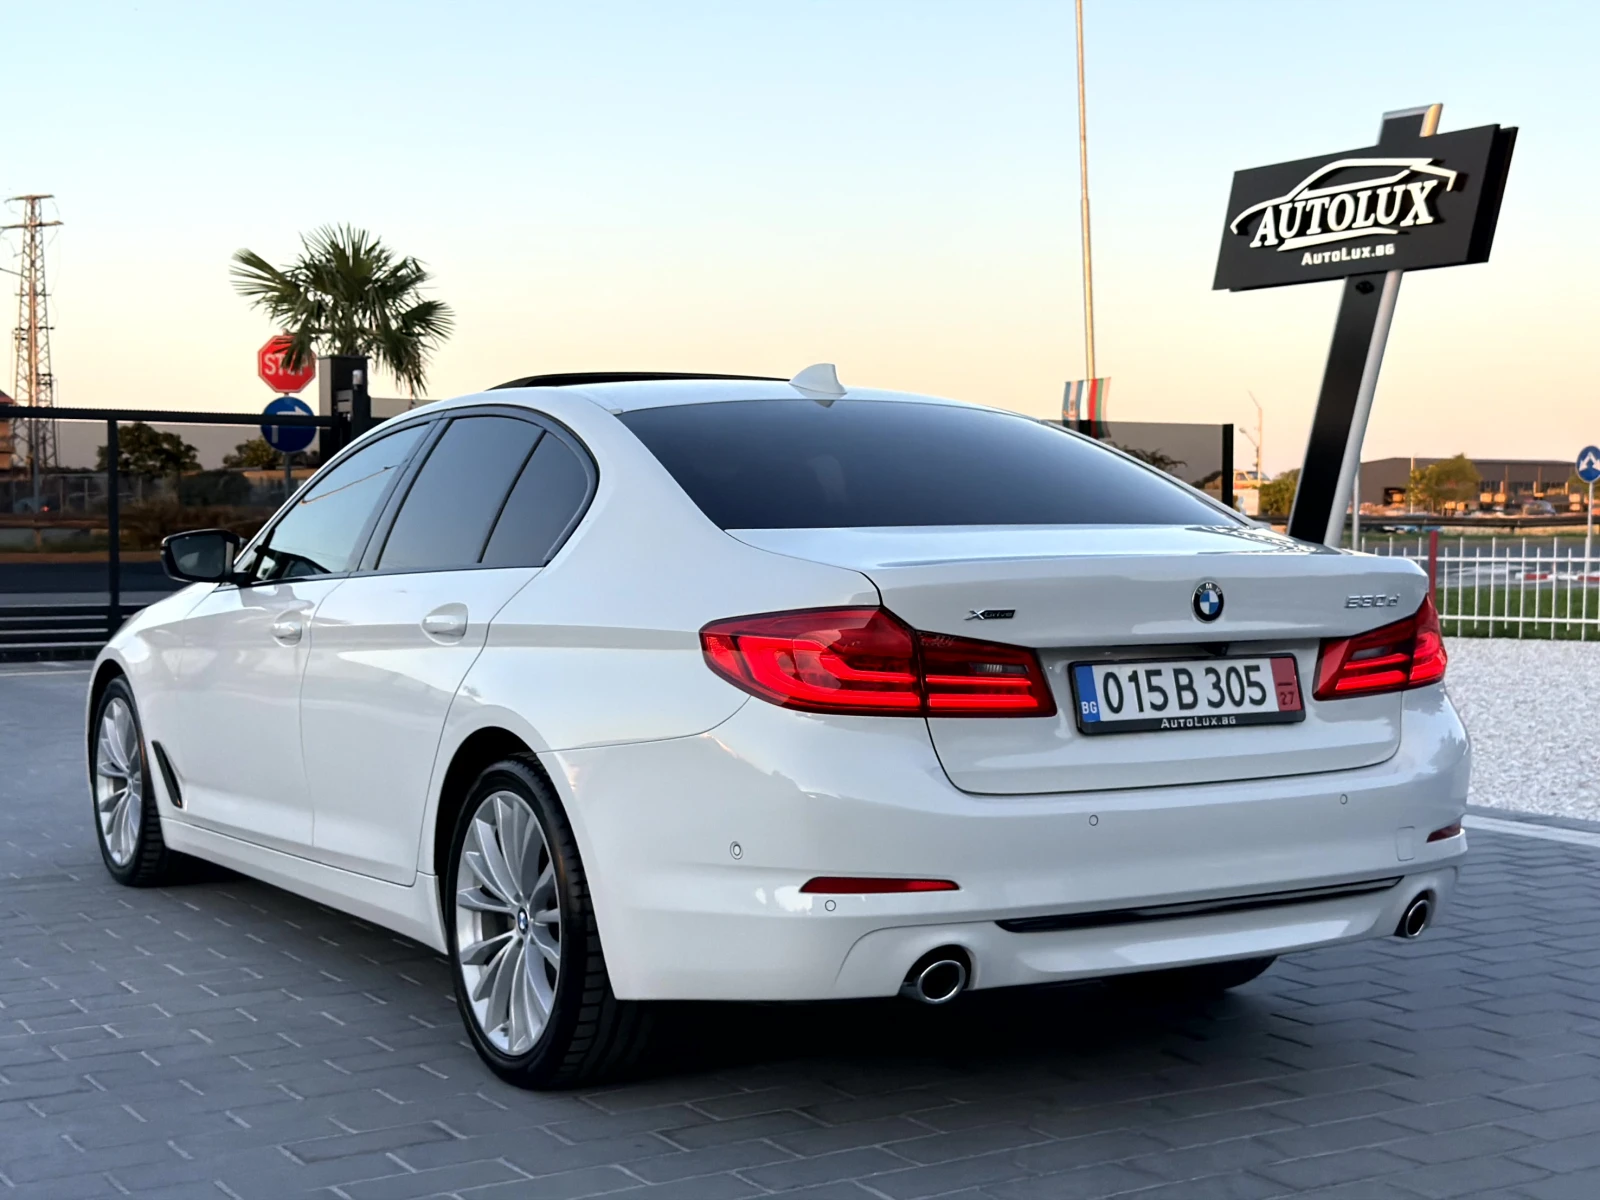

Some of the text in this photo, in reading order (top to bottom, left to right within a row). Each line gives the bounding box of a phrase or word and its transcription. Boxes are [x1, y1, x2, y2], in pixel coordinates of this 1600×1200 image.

[1250, 180, 1437, 248] AUTOLUX
[1280, 691, 1295, 706] 27
[1081, 700, 1098, 714] BG
